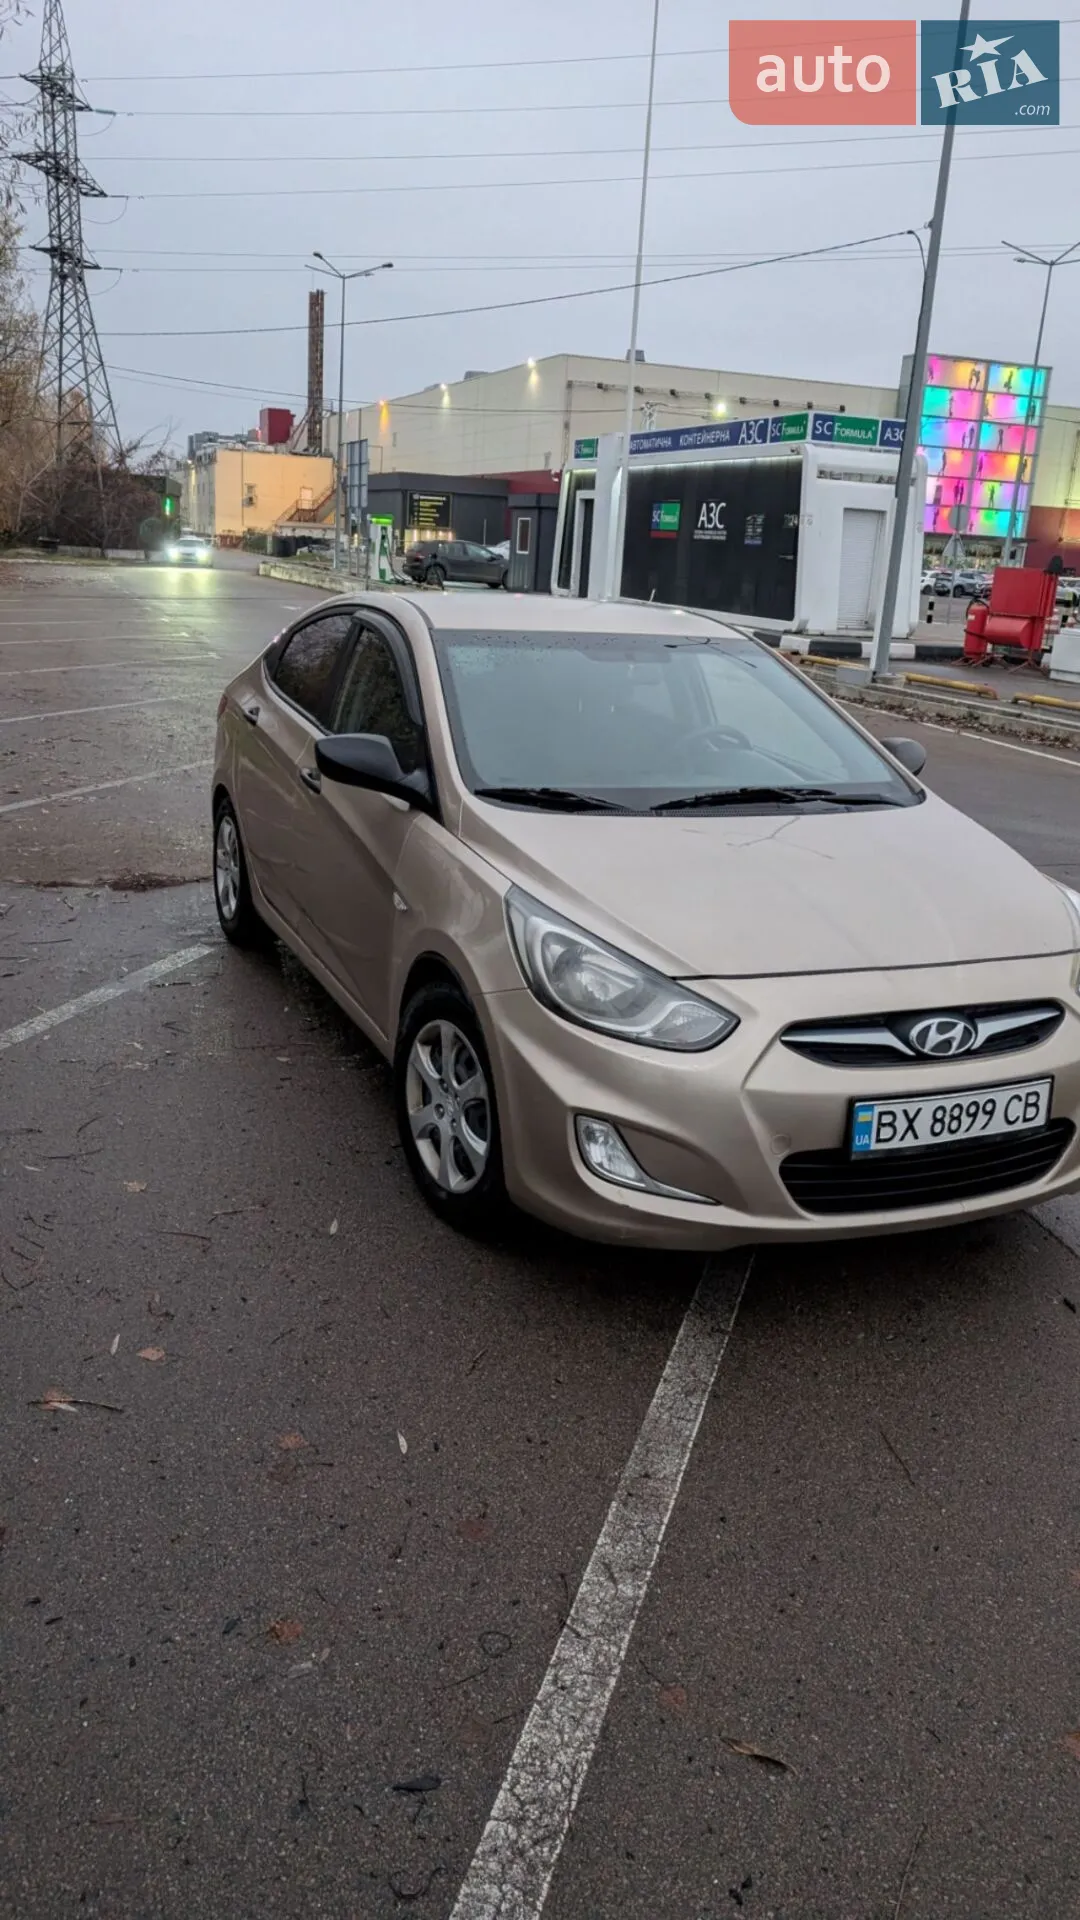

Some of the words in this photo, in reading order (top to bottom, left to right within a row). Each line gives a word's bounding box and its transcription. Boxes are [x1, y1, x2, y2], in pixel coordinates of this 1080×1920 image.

[814, 420, 833, 435] SC
[679, 429, 731, 446] КОНТЕЙНЕРНА
[875, 1107, 923, 1145] BX
[930, 1098, 997, 1138] 8899
[1004, 1090, 1041, 1126] CB
[855, 1134, 870, 1146] UA
